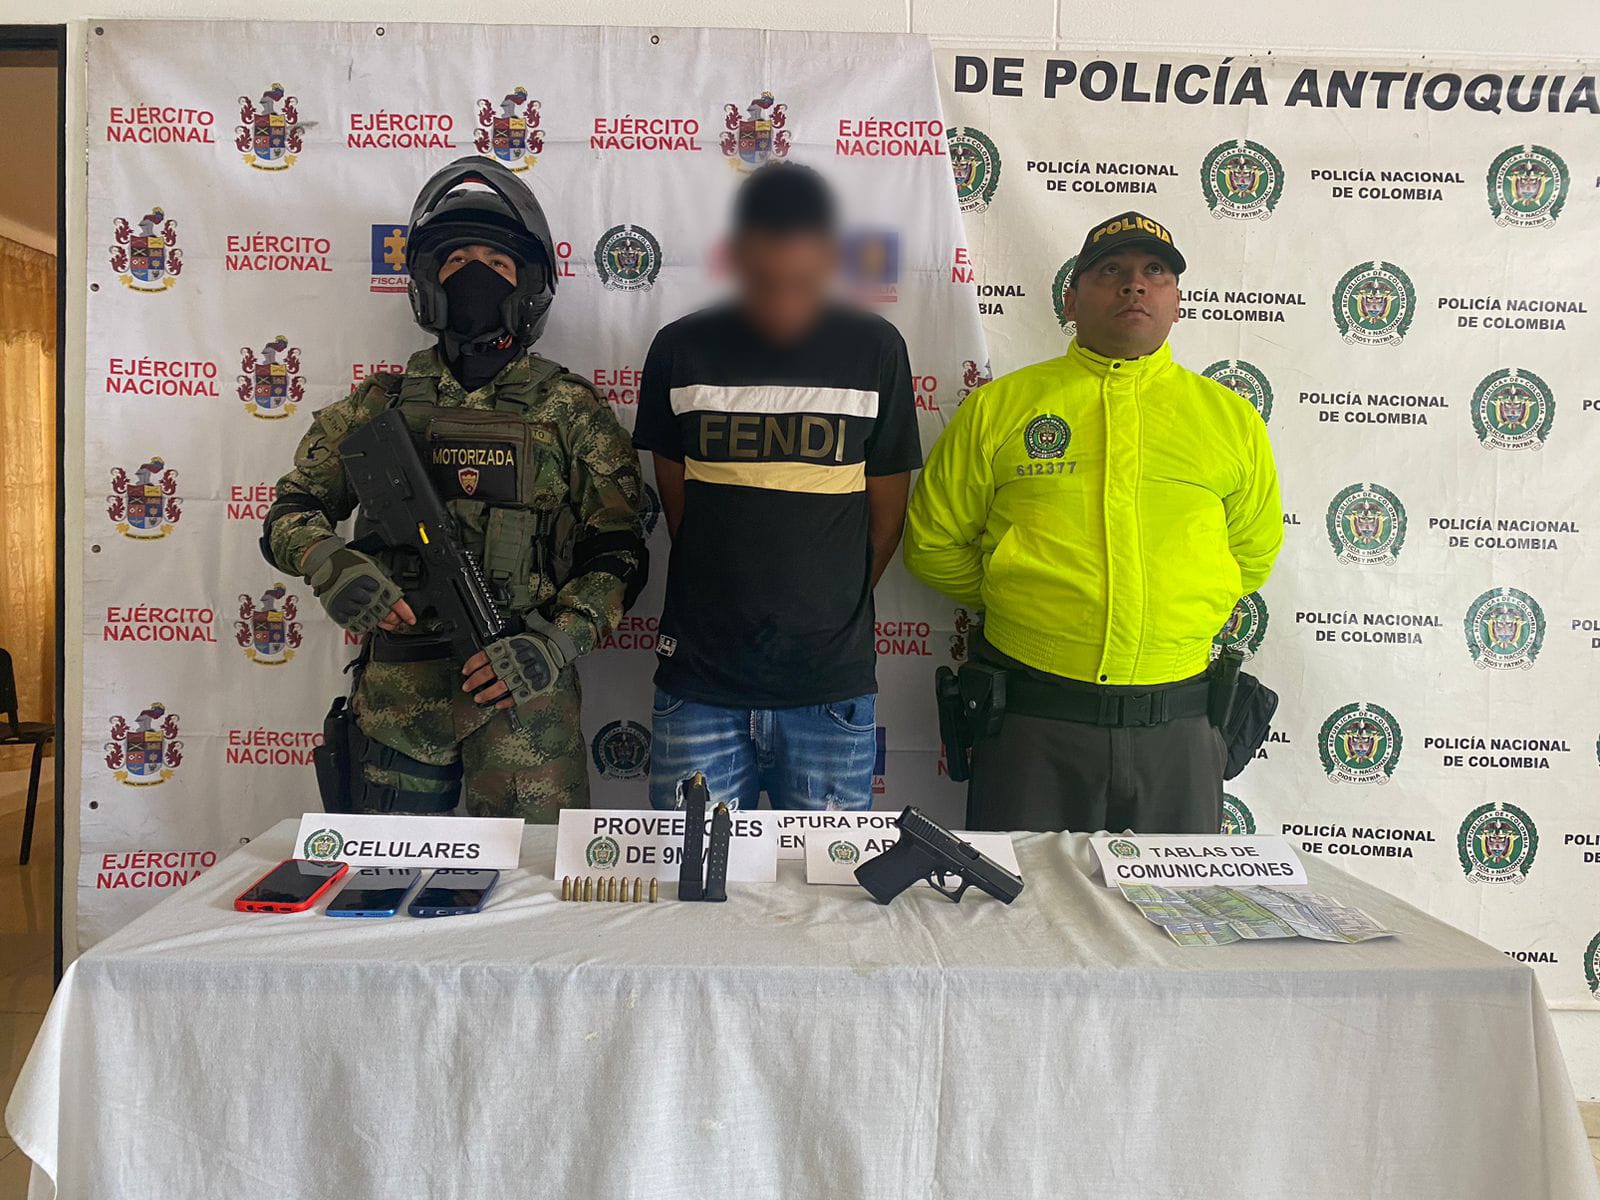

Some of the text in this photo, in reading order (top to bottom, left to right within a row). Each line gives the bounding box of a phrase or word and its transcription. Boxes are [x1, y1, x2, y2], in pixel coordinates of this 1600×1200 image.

[955, 56, 1600, 115] DE POLICÍA ANTIOQUIA
[110, 103, 214, 126] EJÉRCITO
[350, 109, 453, 132] EJÉRCITO
[594, 115, 699, 135] EJÉRCITO
[838, 118, 943, 137] EJÉRCITO
[107, 126, 215, 144] NACIONAL
[347, 133, 456, 148] NACIONAL
[590, 135, 702, 151] NACIONAL
[835, 139, 946, 156] NACIONAL
[1027, 160, 1178, 175] POLICÍA NACIONAL
[1311, 169, 1464, 183] POLICÍA NACIONAL
[1047, 180, 1157, 193] DE COLOMBIA
[1333, 187, 1442, 200] DE COLOMBIA
[960, 202, 979, 211] ATRIA
[227, 232, 330, 254] EJÉRCITO
[225, 254, 333, 272] NACIONAL
[371, 277, 408, 285] FISCAL
[977, 286, 1025, 296] IONAL
[1180, 288, 1305, 305] LICÍA NACIONAL
[1439, 298, 1587, 313] POLICÍA NACIONAL
[1202, 309, 1284, 322] COLOMBIA
[1458, 317, 1565, 330] DE COLOMBIA
[109, 357, 217, 378] EJÉRCITO
[106, 378, 219, 396] NACIONAL
[1300, 393, 1448, 407] POLICÍA NACIONAL
[1320, 411, 1427, 424] DE COLOMBIA
[699, 415, 847, 462] FENDI
[432, 448, 514, 466] MOTORIZADA
[1016, 461, 1077, 476] 612377
[1430, 517, 1579, 532] POLICÍA NACIONAL
[1449, 537, 1557, 549] DE COLOMBIA
[107, 603, 213, 624] EJÉRCITO
[1243, 596, 1257, 626] OLOMBIA
[1296, 612, 1442, 626] POLICÍA NACIONAL
[103, 625, 217, 643] NACIONAL
[1316, 631, 1422, 643] DE COLOMBIA
[875, 638, 932, 655] ONAL
[1425, 736, 1570, 751] POLICÍA NACIONAL
[226, 748, 314, 766] NACIONA
[1444, 756, 1549, 768] DE COLOMBIA
[593, 817, 763, 837] PROVEEES
[777, 815, 850, 829] PTURA
[1228, 805, 1245, 833] COLOMBI
[1283, 824, 1435, 841] POLICÍA NACIONAL
[1564, 834, 1600, 846] POLI
[343, 841, 479, 859] CELULARES
[627, 846, 655, 863] DE
[1149, 847, 1259, 857] TABLAS DE
[1303, 843, 1413, 857] DE COLOMBIA
[102, 849, 216, 870] EJÉRCITO
[1117, 863, 1293, 878] COMUNICACIONES
[97, 870, 201, 888] NACIONA
